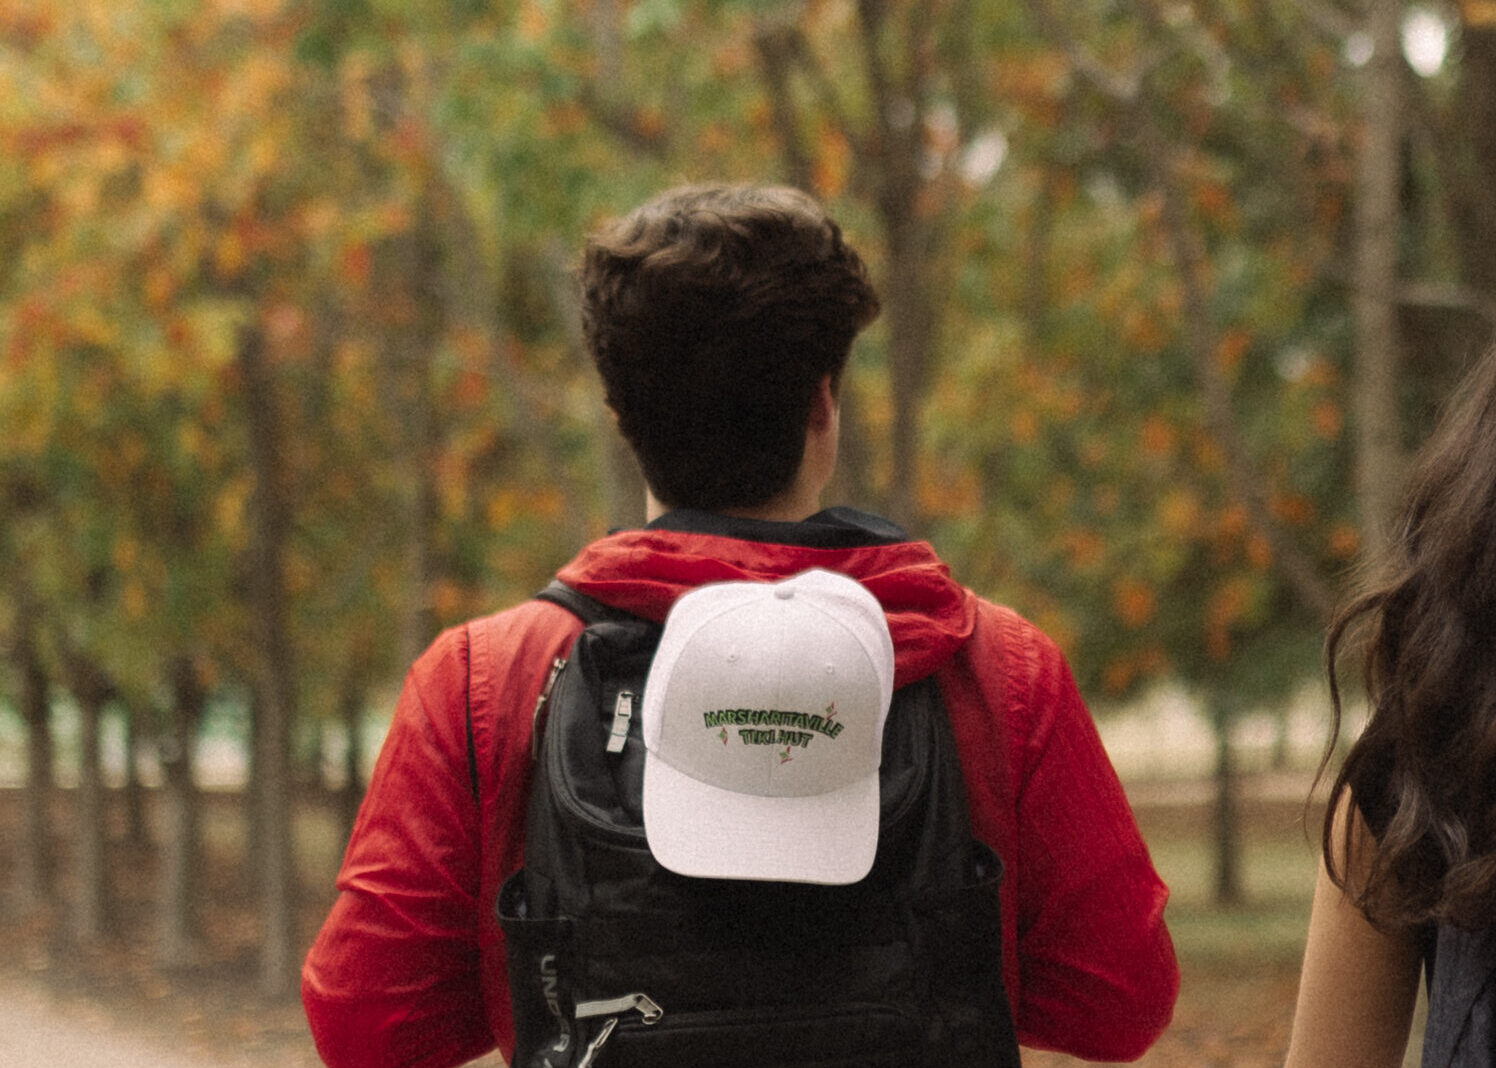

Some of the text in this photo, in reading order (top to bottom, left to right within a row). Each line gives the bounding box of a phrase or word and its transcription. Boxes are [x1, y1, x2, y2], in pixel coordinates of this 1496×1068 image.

[703, 708, 845, 740] MARSHARITAVILLE
[738, 729, 814, 748] TIKI HUT
[540, 954, 571, 1054] UNDER
